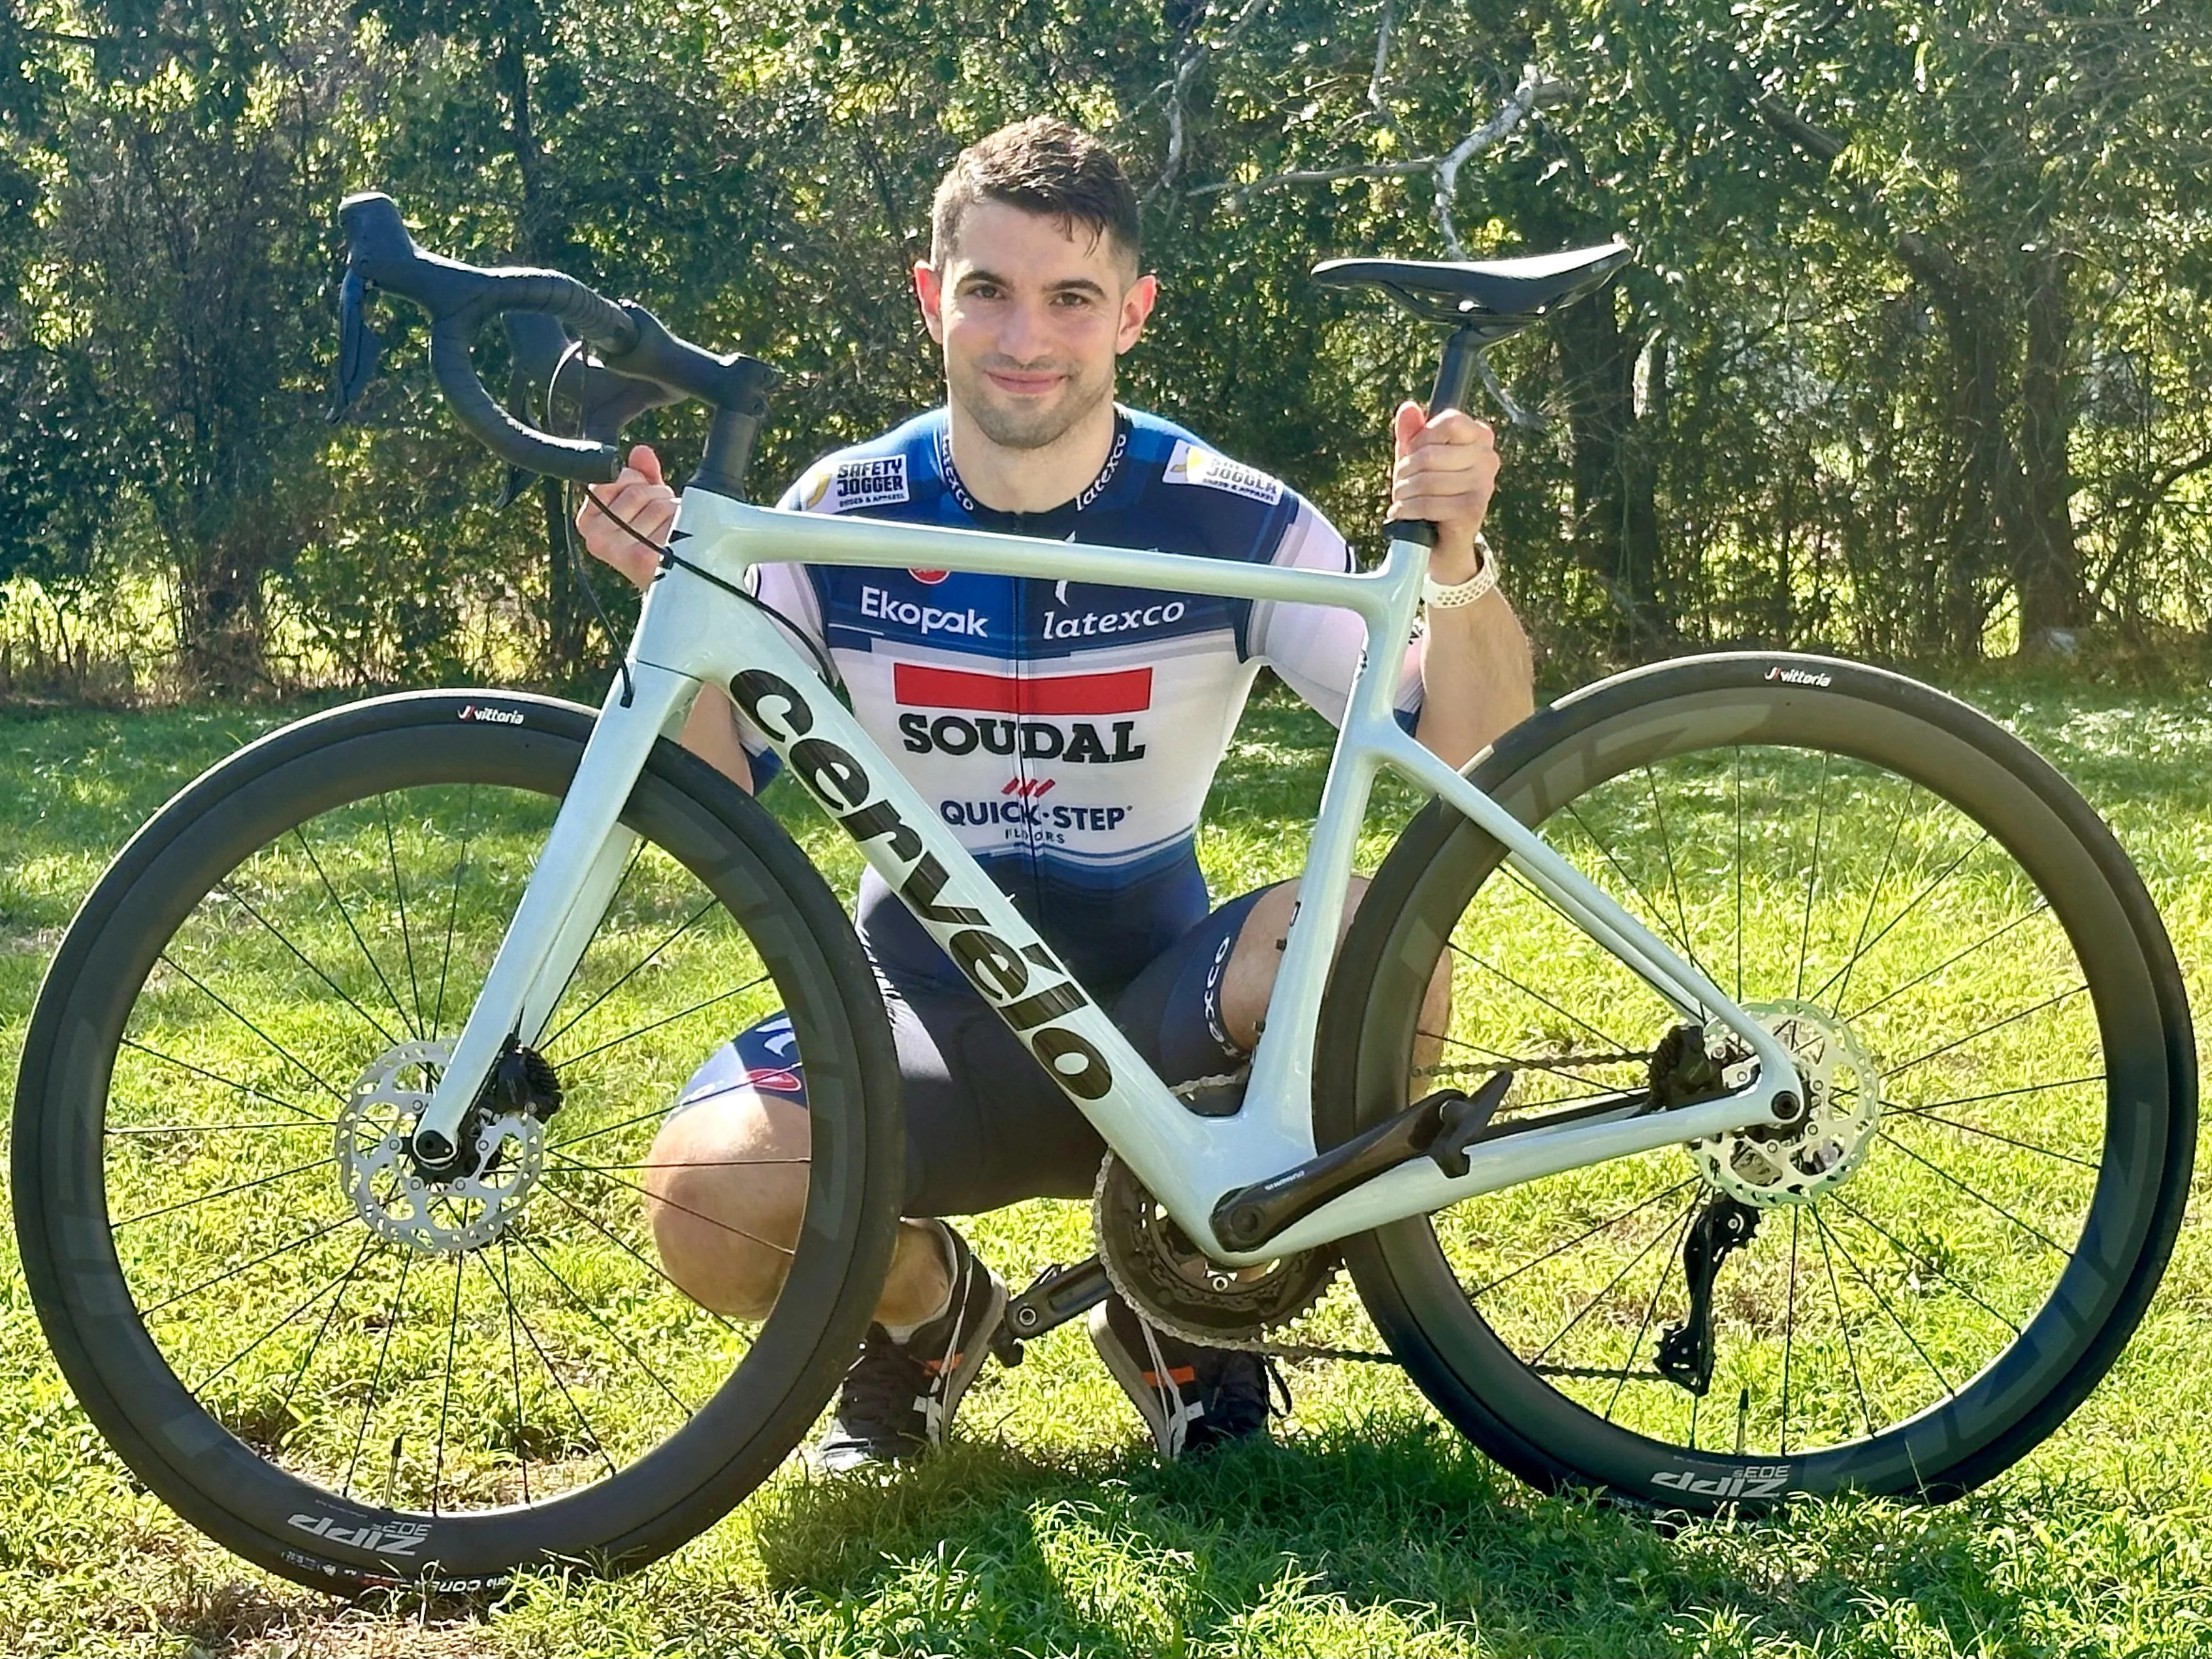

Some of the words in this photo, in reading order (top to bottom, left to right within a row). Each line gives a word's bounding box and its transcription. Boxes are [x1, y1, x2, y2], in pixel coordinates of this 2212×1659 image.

[837, 458, 902, 478] SAFETY
[837, 475, 903, 497] JOGGER
[1075, 434, 1127, 511] latexco
[860, 585, 988, 638] Ekopak
[1042, 600, 1185, 640] latexco
[1780, 668, 1832, 687] vittoria
[474, 707, 525, 725] vittoria
[898, 713, 1145, 764] SOUDAL
[730, 668, 1113, 1100] cervélo
[1651, 1471, 1789, 1498] ZIPP
[287, 1513, 426, 1556] ZIPP
